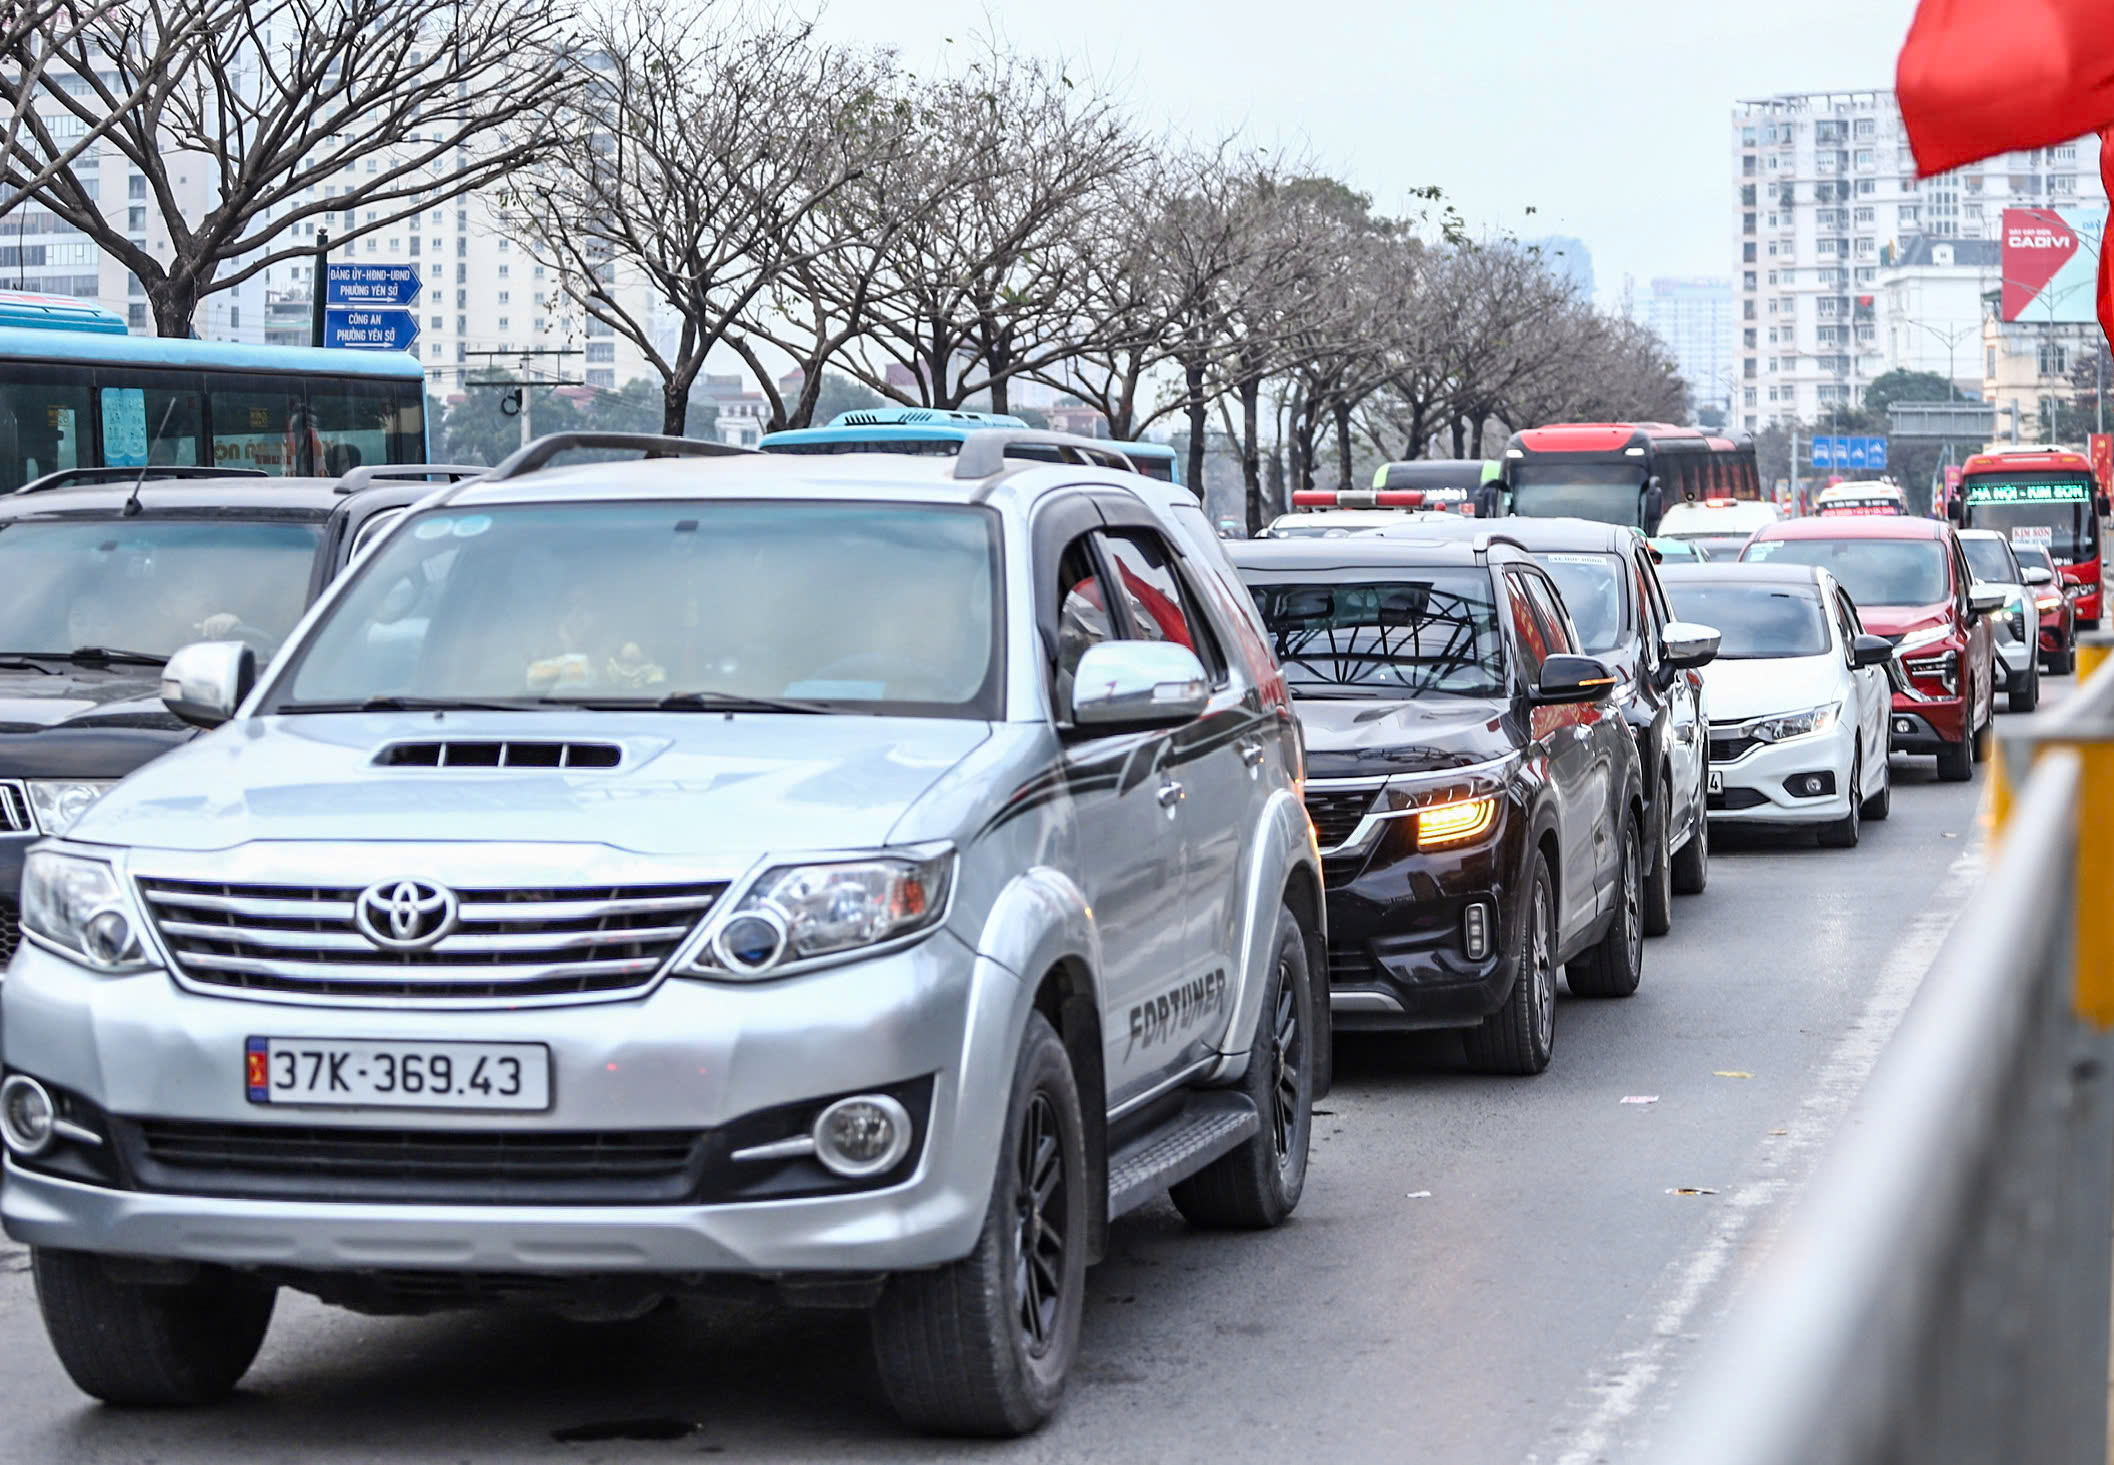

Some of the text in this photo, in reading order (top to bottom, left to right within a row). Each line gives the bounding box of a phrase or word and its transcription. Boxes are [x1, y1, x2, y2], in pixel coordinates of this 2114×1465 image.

[2008, 236, 2070, 248] CADIVI
[348, 312, 381, 324] CÔNG AN
[2027, 486, 2052, 498] KIM
[1123, 968, 1226, 1062] FORTUNER
[274, 1050, 521, 1096] 37K-369.43
